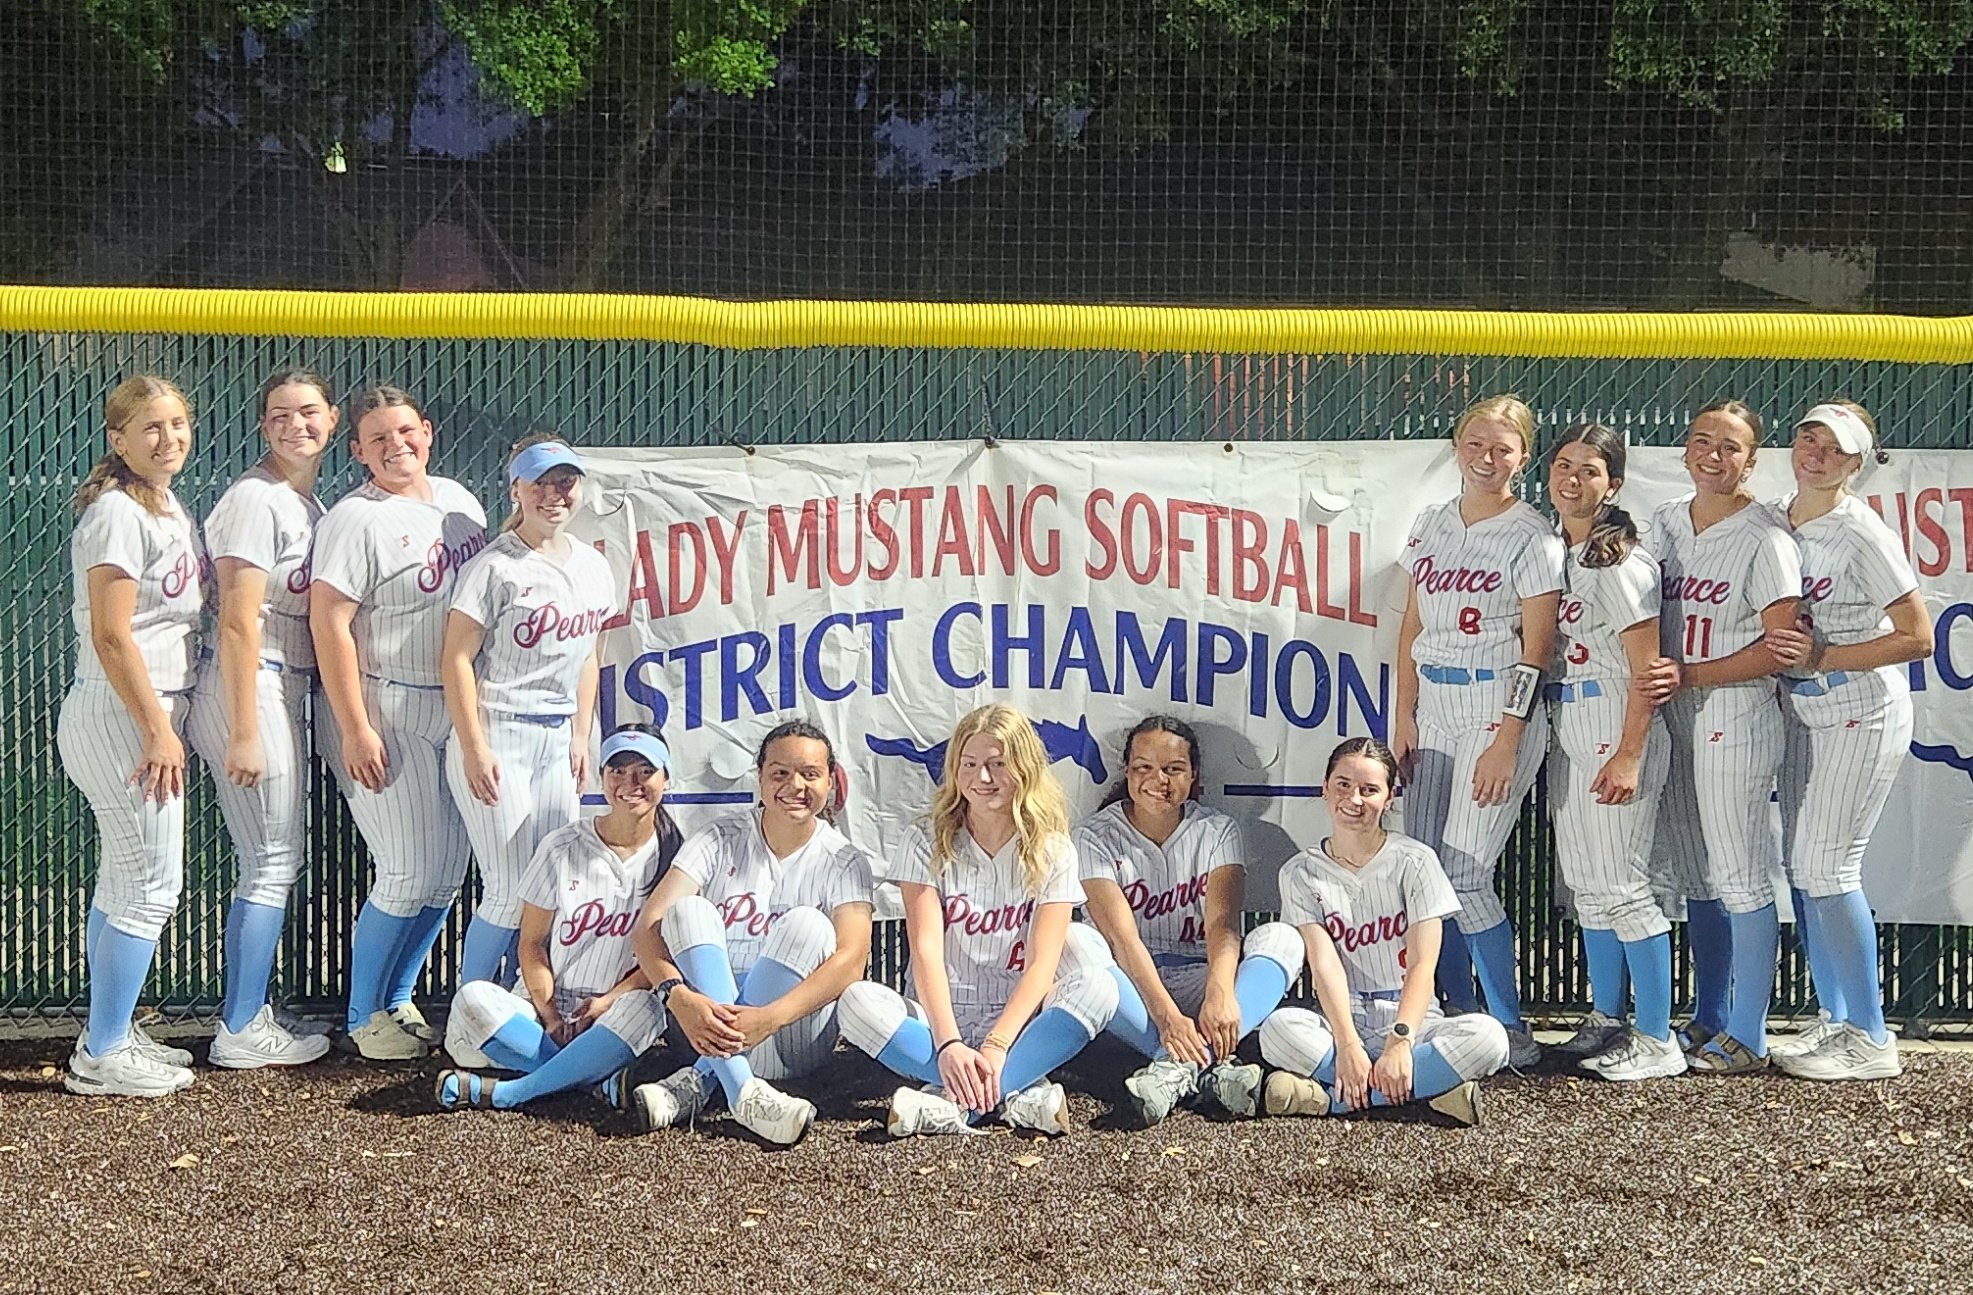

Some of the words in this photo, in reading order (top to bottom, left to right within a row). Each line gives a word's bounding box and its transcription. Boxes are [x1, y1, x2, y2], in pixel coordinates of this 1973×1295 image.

[766, 484, 1061, 598] MUSTANG
[1085, 488, 1378, 628] SOFTBALL
[1412, 555, 1503, 595] Pearce
[1685, 613, 1713, 659] 11
[599, 607, 904, 741] ISTRICT
[932, 602, 1390, 746] CHAMPION
[1324, 910, 1409, 953] Pearc
